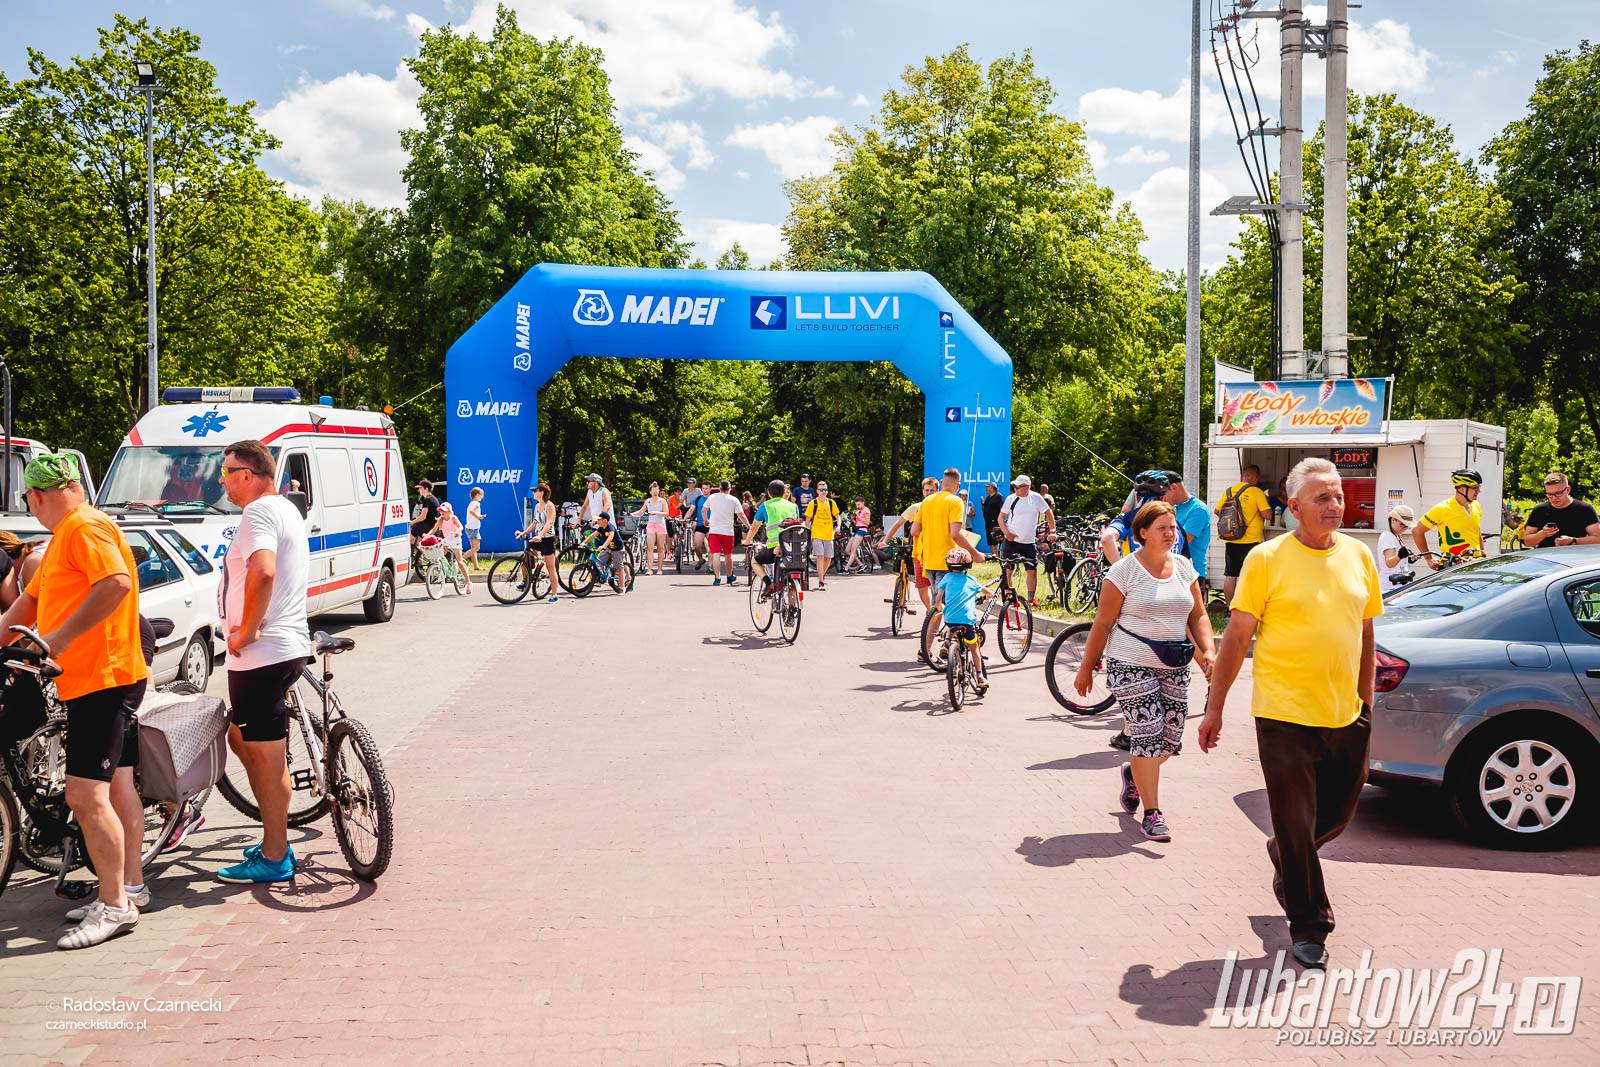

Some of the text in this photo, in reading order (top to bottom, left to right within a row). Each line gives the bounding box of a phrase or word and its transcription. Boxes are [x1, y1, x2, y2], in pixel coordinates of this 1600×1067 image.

[620, 294, 720, 326] MAPEI
[795, 295, 900, 320] LUVI
[515, 302, 531, 350] MAPEI
[795, 324, 900, 332] LET'S BUILD TOGETHER
[944, 331, 956, 379] LUVI
[475, 401, 521, 416] MAPEI
[964, 406, 1006, 418] LUVI
[1291, 405, 1370, 427] włoskie
[1333, 452, 1370, 463] LODY
[366, 466, 376, 487] R
[476, 469, 522, 484] MAPEI
[963, 471, 1005, 483] LUVI
[391, 504, 404, 518] 999
